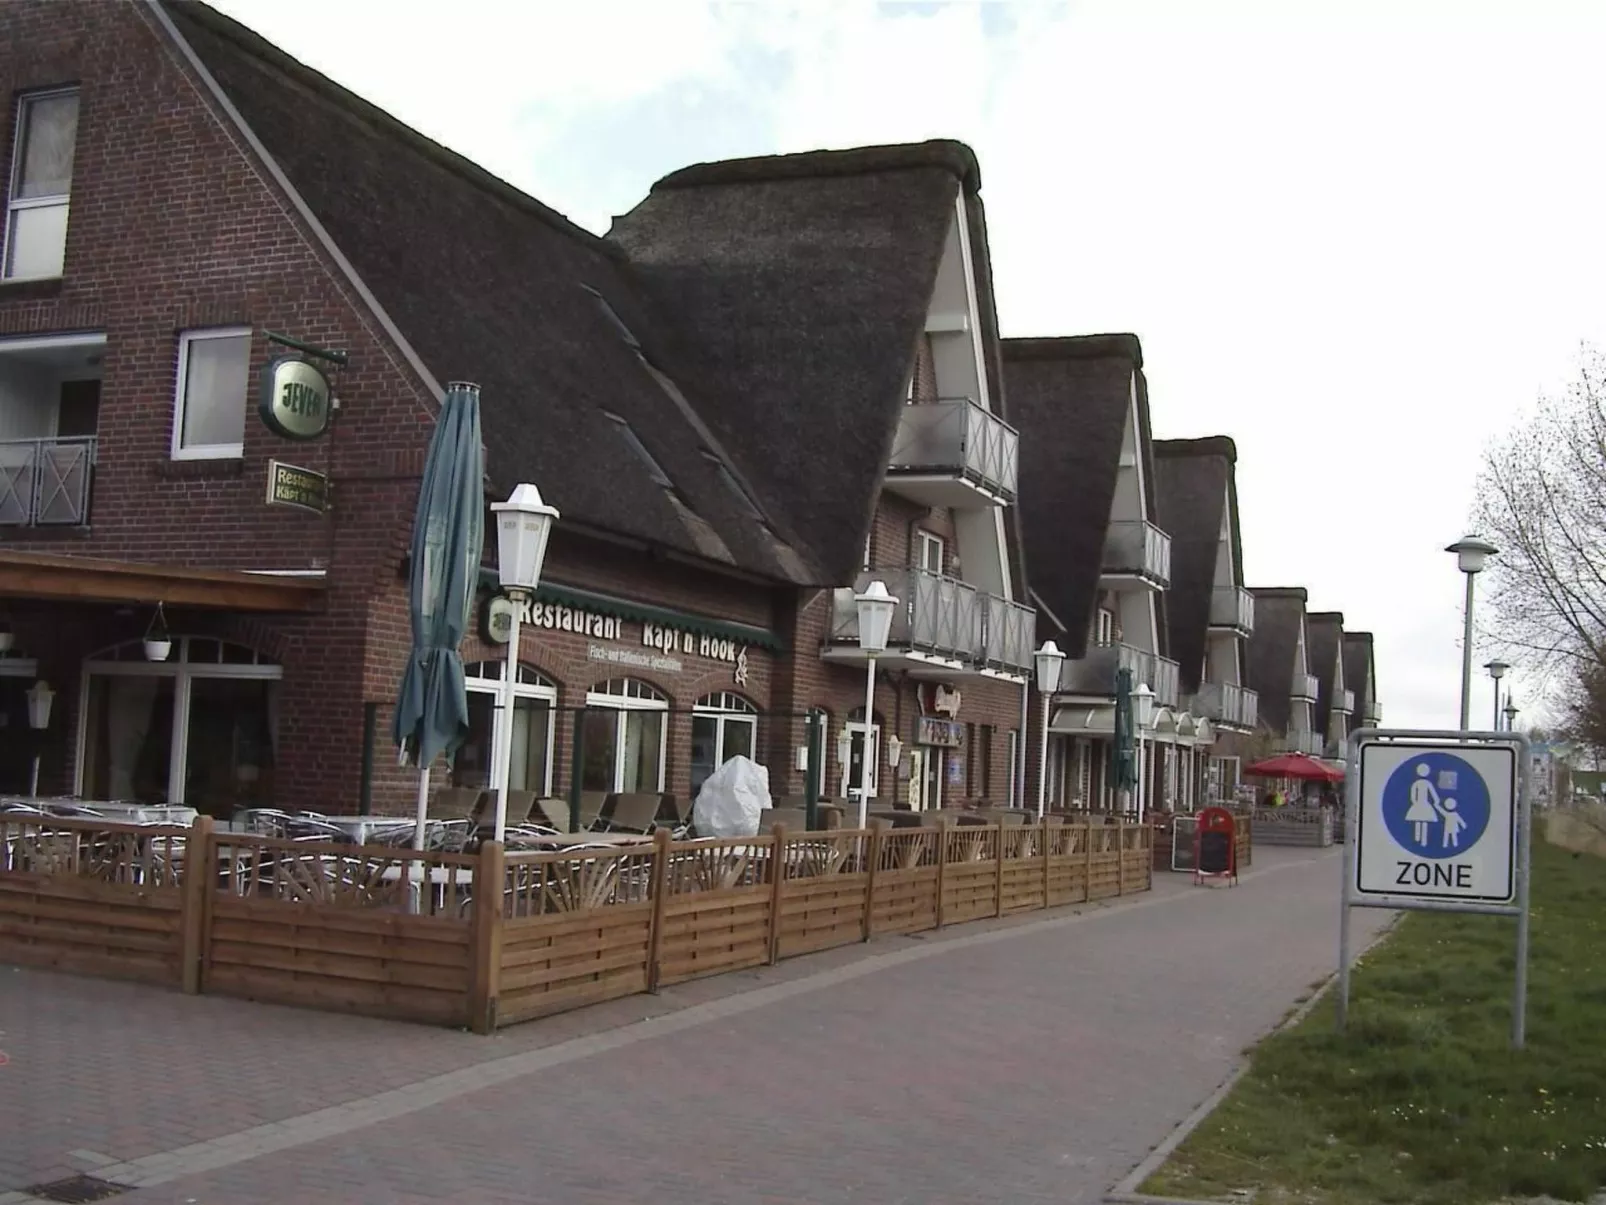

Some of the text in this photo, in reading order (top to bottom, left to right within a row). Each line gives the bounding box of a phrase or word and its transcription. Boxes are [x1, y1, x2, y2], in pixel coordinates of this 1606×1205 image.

[282, 382, 321, 417] JEVER
[519, 597, 622, 640] Restaurant
[1396, 861, 1473, 888] ZONE
